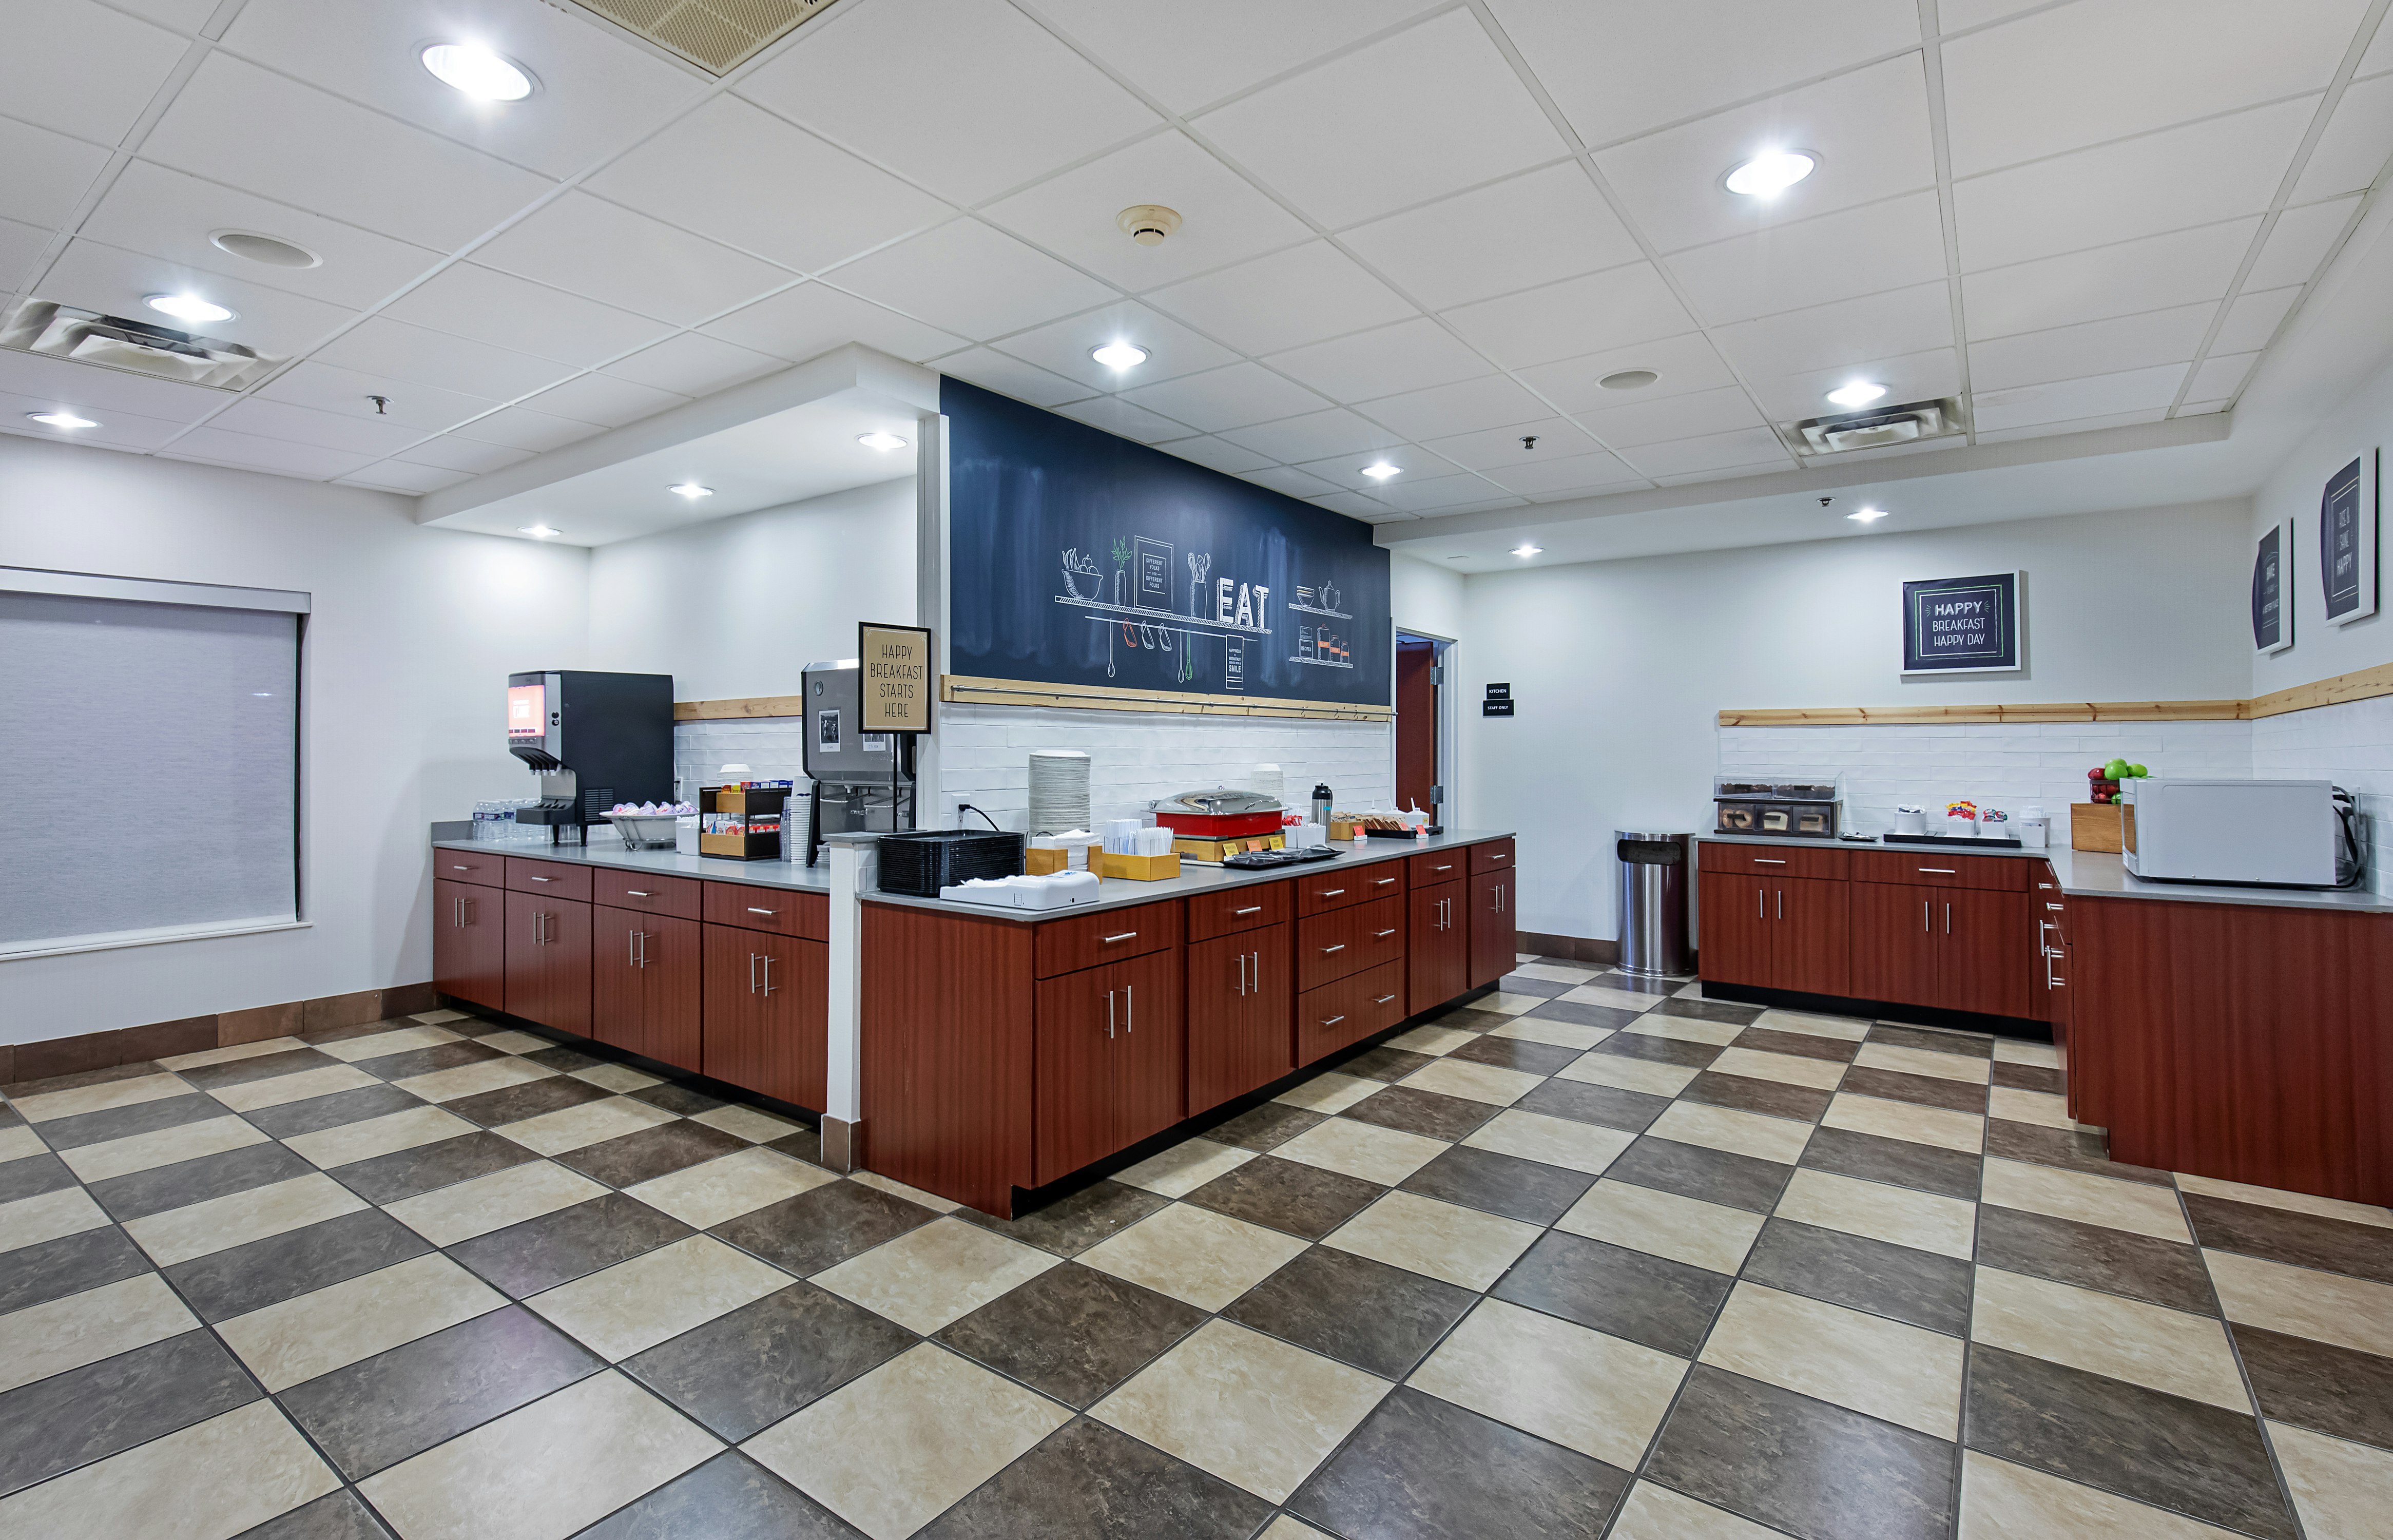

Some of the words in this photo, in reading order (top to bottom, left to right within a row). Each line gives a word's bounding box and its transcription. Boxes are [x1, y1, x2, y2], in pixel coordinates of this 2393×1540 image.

[1146, 557, 1163, 566] DIFFERENT
[1217, 578, 1269, 628] EAT
[1935, 601, 1983, 617] HAPPY
[1933, 618, 1985, 632] BREAKFAST
[1934, 634, 1964, 647] HAPPY
[1967, 633, 1985, 645] DAY
[882, 644, 912, 660] HAPPY
[871, 663, 923, 680] BREAKFAST
[1229, 665, 1241, 673] SMILE
[880, 683, 913, 699] STARTS
[885, 703, 909, 718] HERE
